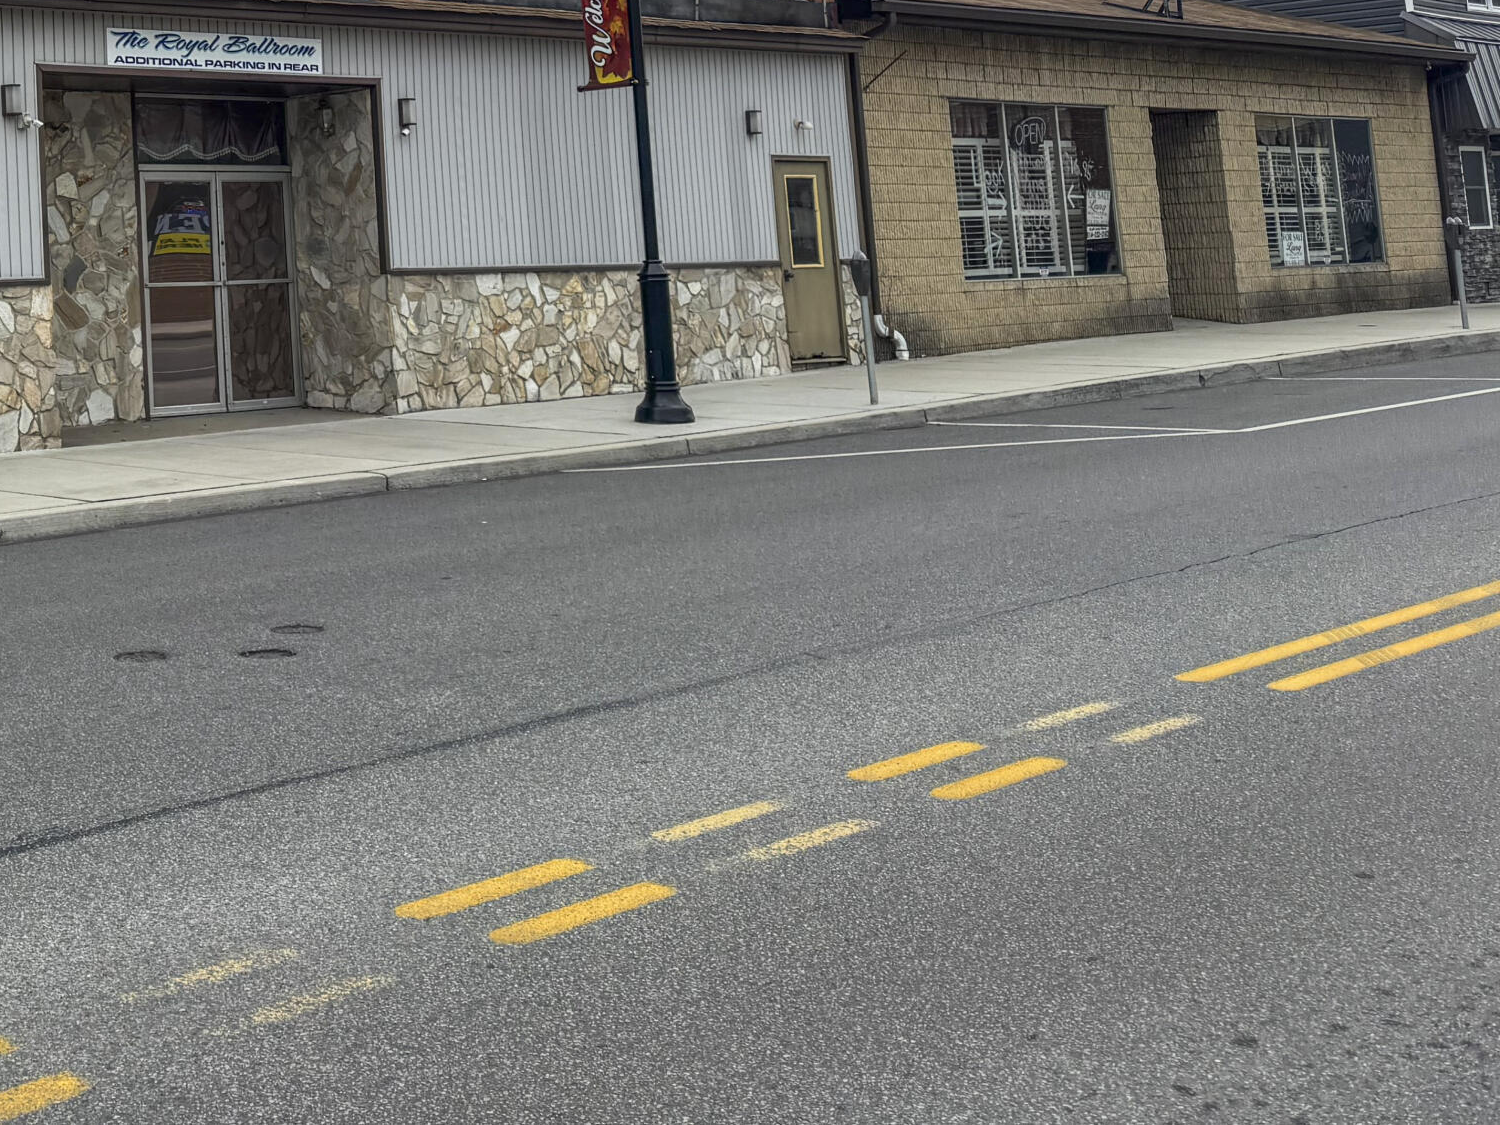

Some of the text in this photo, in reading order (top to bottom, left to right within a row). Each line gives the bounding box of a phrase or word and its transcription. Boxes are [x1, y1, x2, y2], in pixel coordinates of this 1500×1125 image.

[110, 30, 316, 57] The Royal Ballroom
[114, 55, 319, 72] ADDITIONAL PARKING IN REAR
[1014, 122, 1045, 146] OPEN
